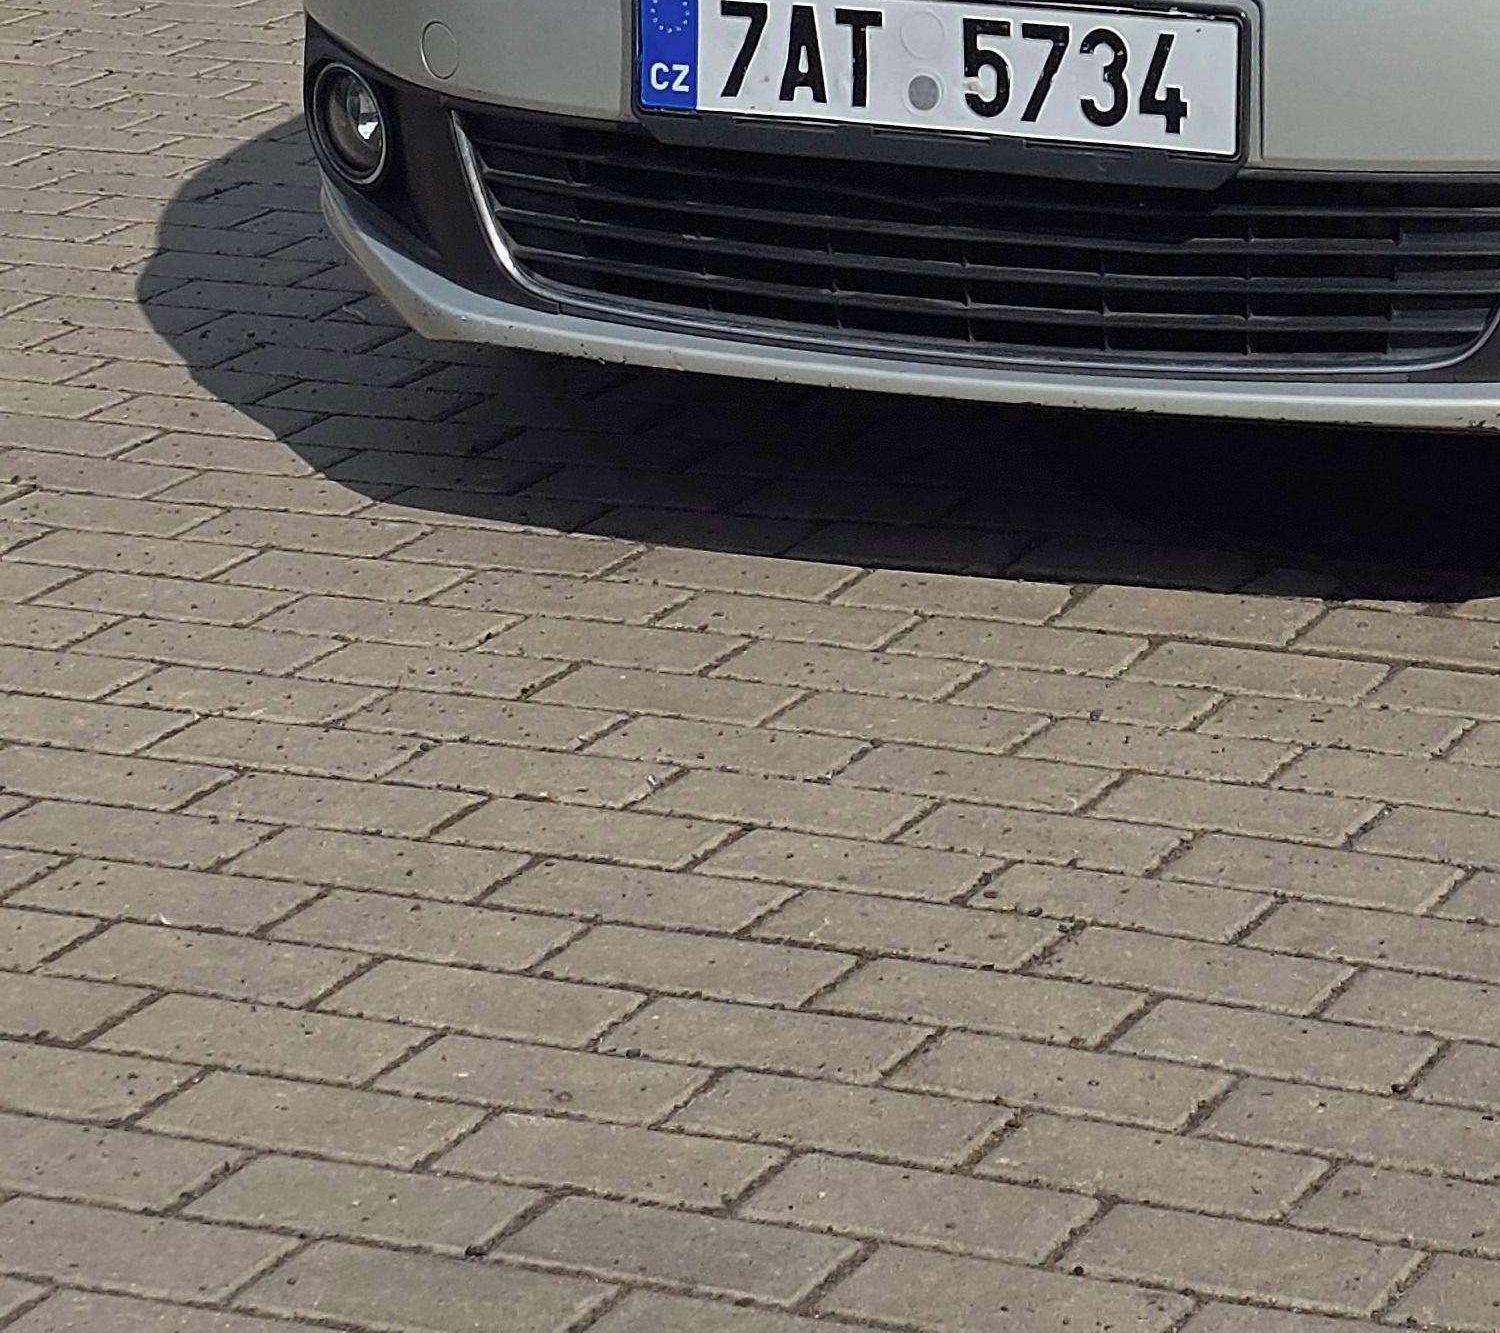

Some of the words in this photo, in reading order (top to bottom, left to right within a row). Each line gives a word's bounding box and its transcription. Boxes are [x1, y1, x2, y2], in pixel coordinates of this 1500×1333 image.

[650, 62, 690, 93] CZ
[719, 0, 883, 107] 7AT
[962, 17, 1188, 135] 5734
